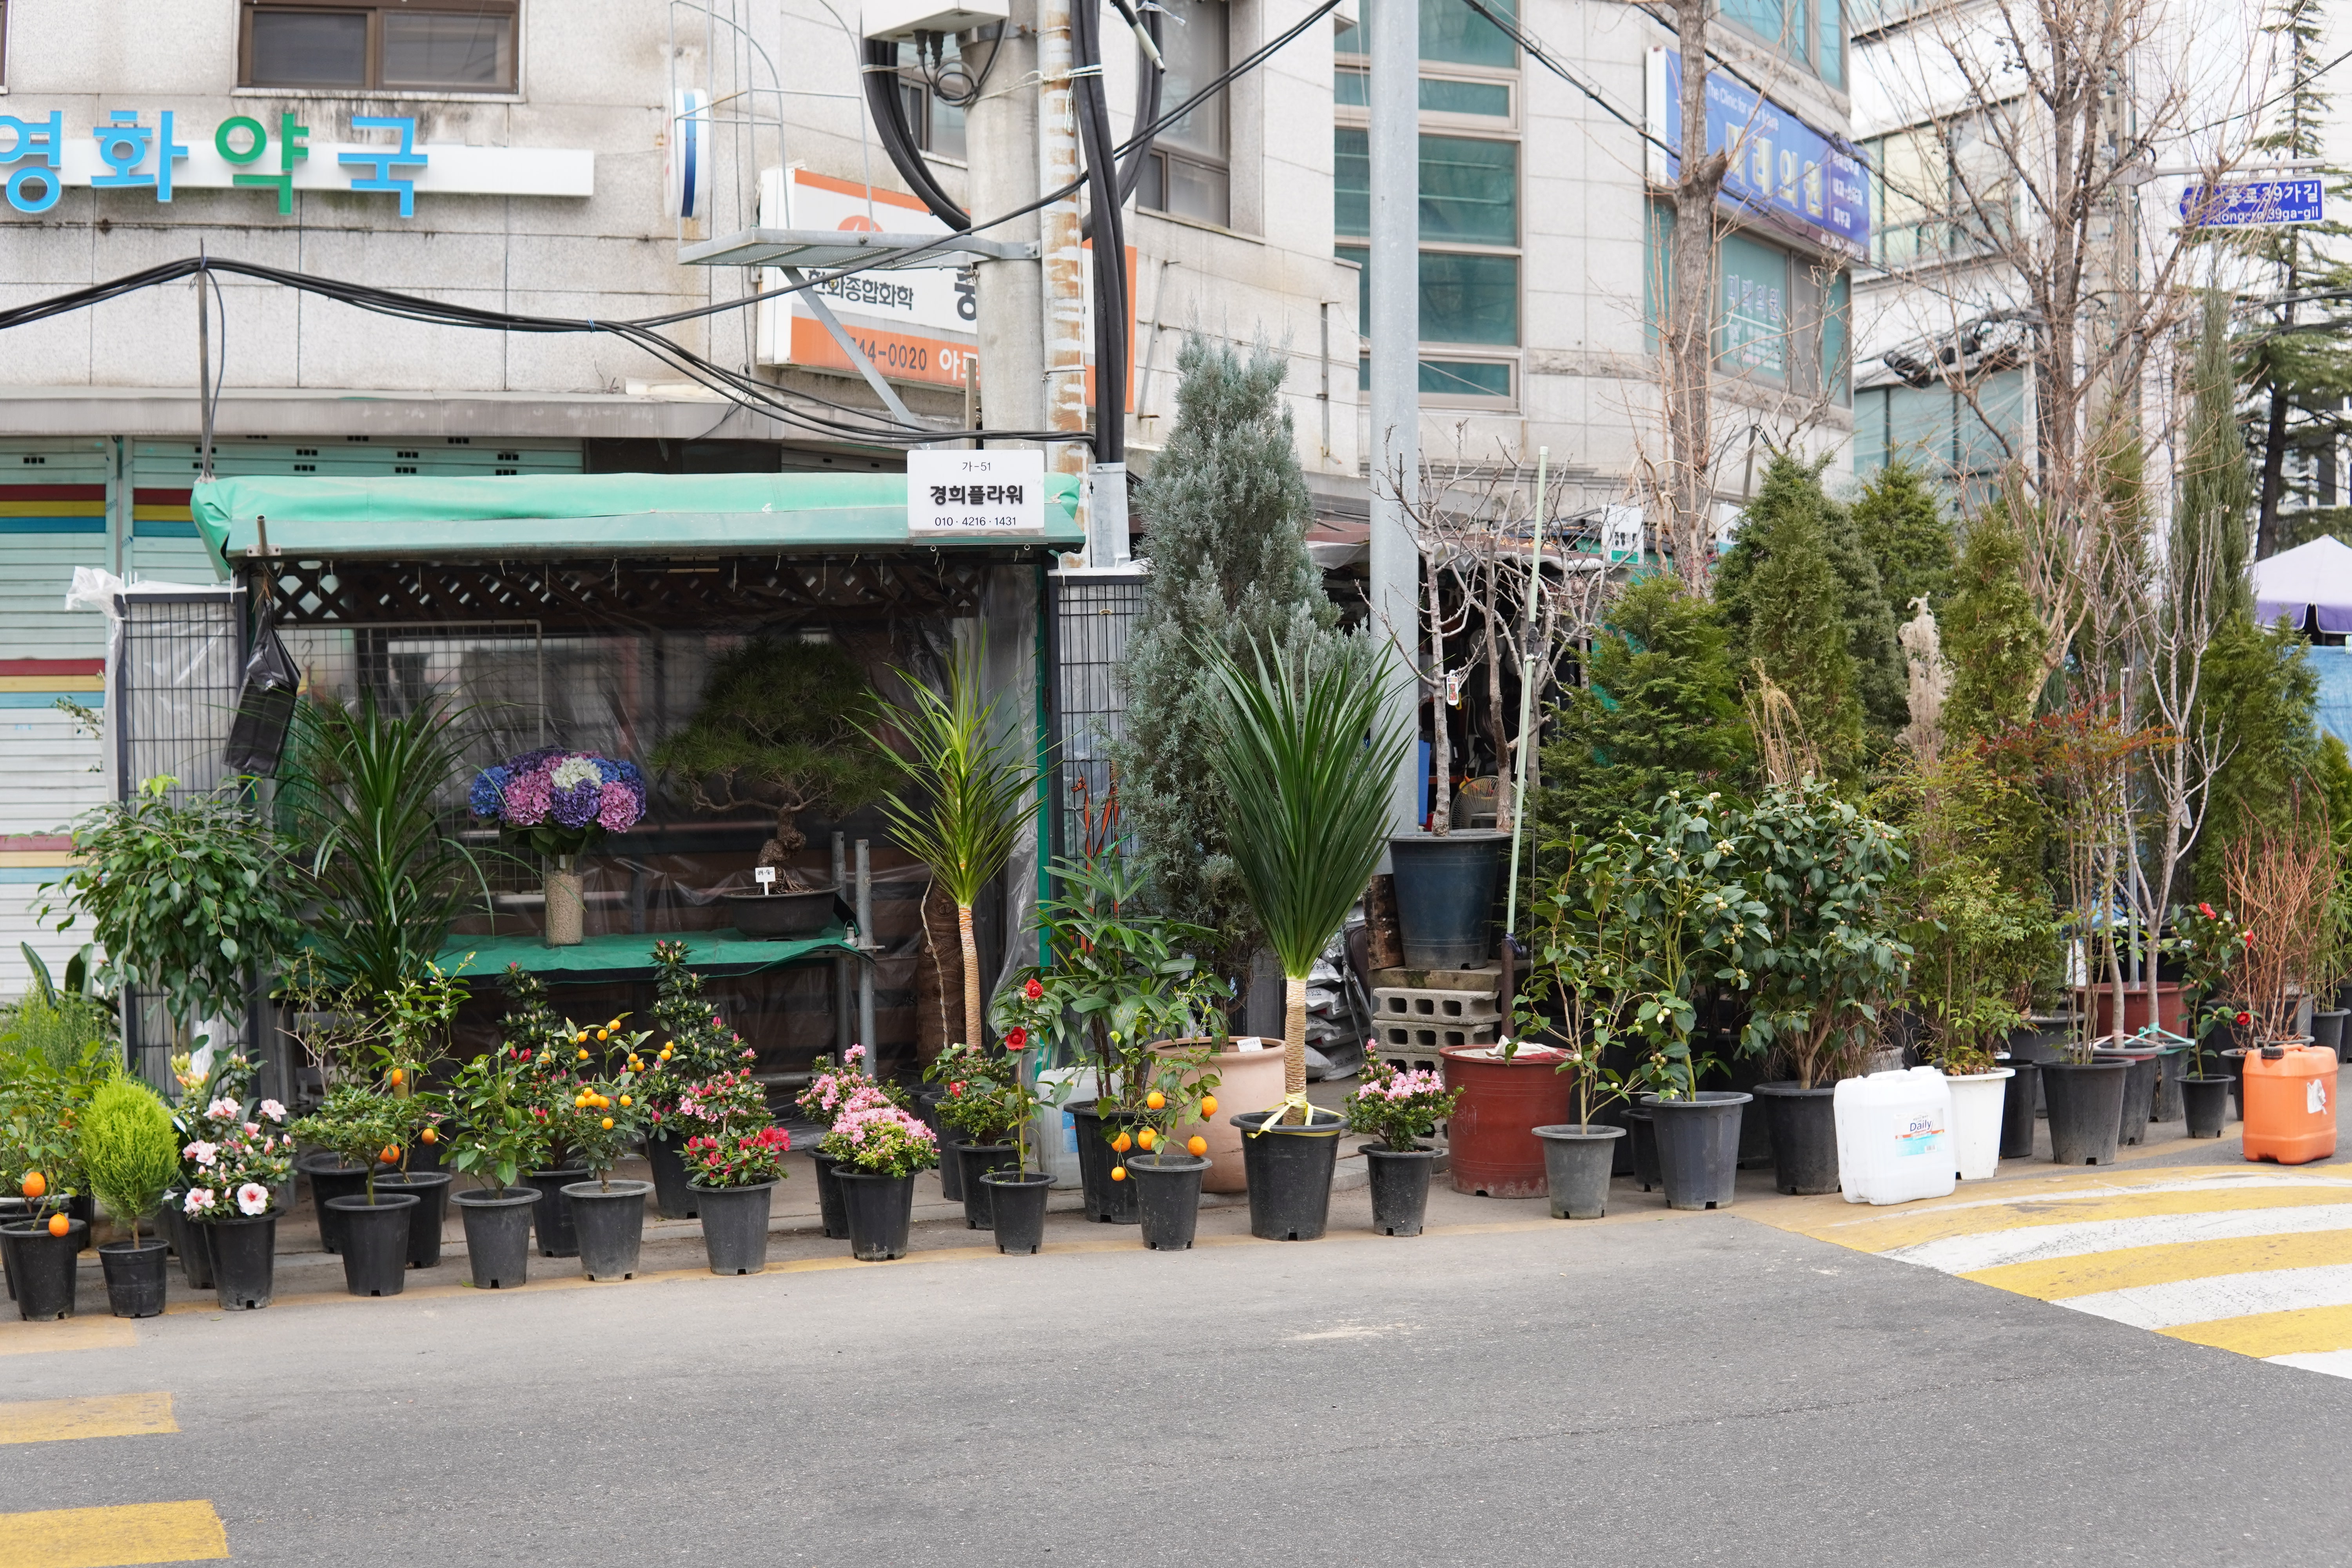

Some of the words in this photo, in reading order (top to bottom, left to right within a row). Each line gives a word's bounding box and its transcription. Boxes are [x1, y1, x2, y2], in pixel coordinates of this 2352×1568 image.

[1720, 87, 1738, 111] Clinic
[1738, 96, 1747, 114] for
[0, 110, 428, 218] 영화약국
[1833, 206, 1851, 229] 피부과
[808, 269, 914, 310] 한화종합화학
[962, 461, 991, 472] 가-51
[930, 485, 1023, 505] 경희플라워
[1910, 1120, 1932, 1132] Daily
